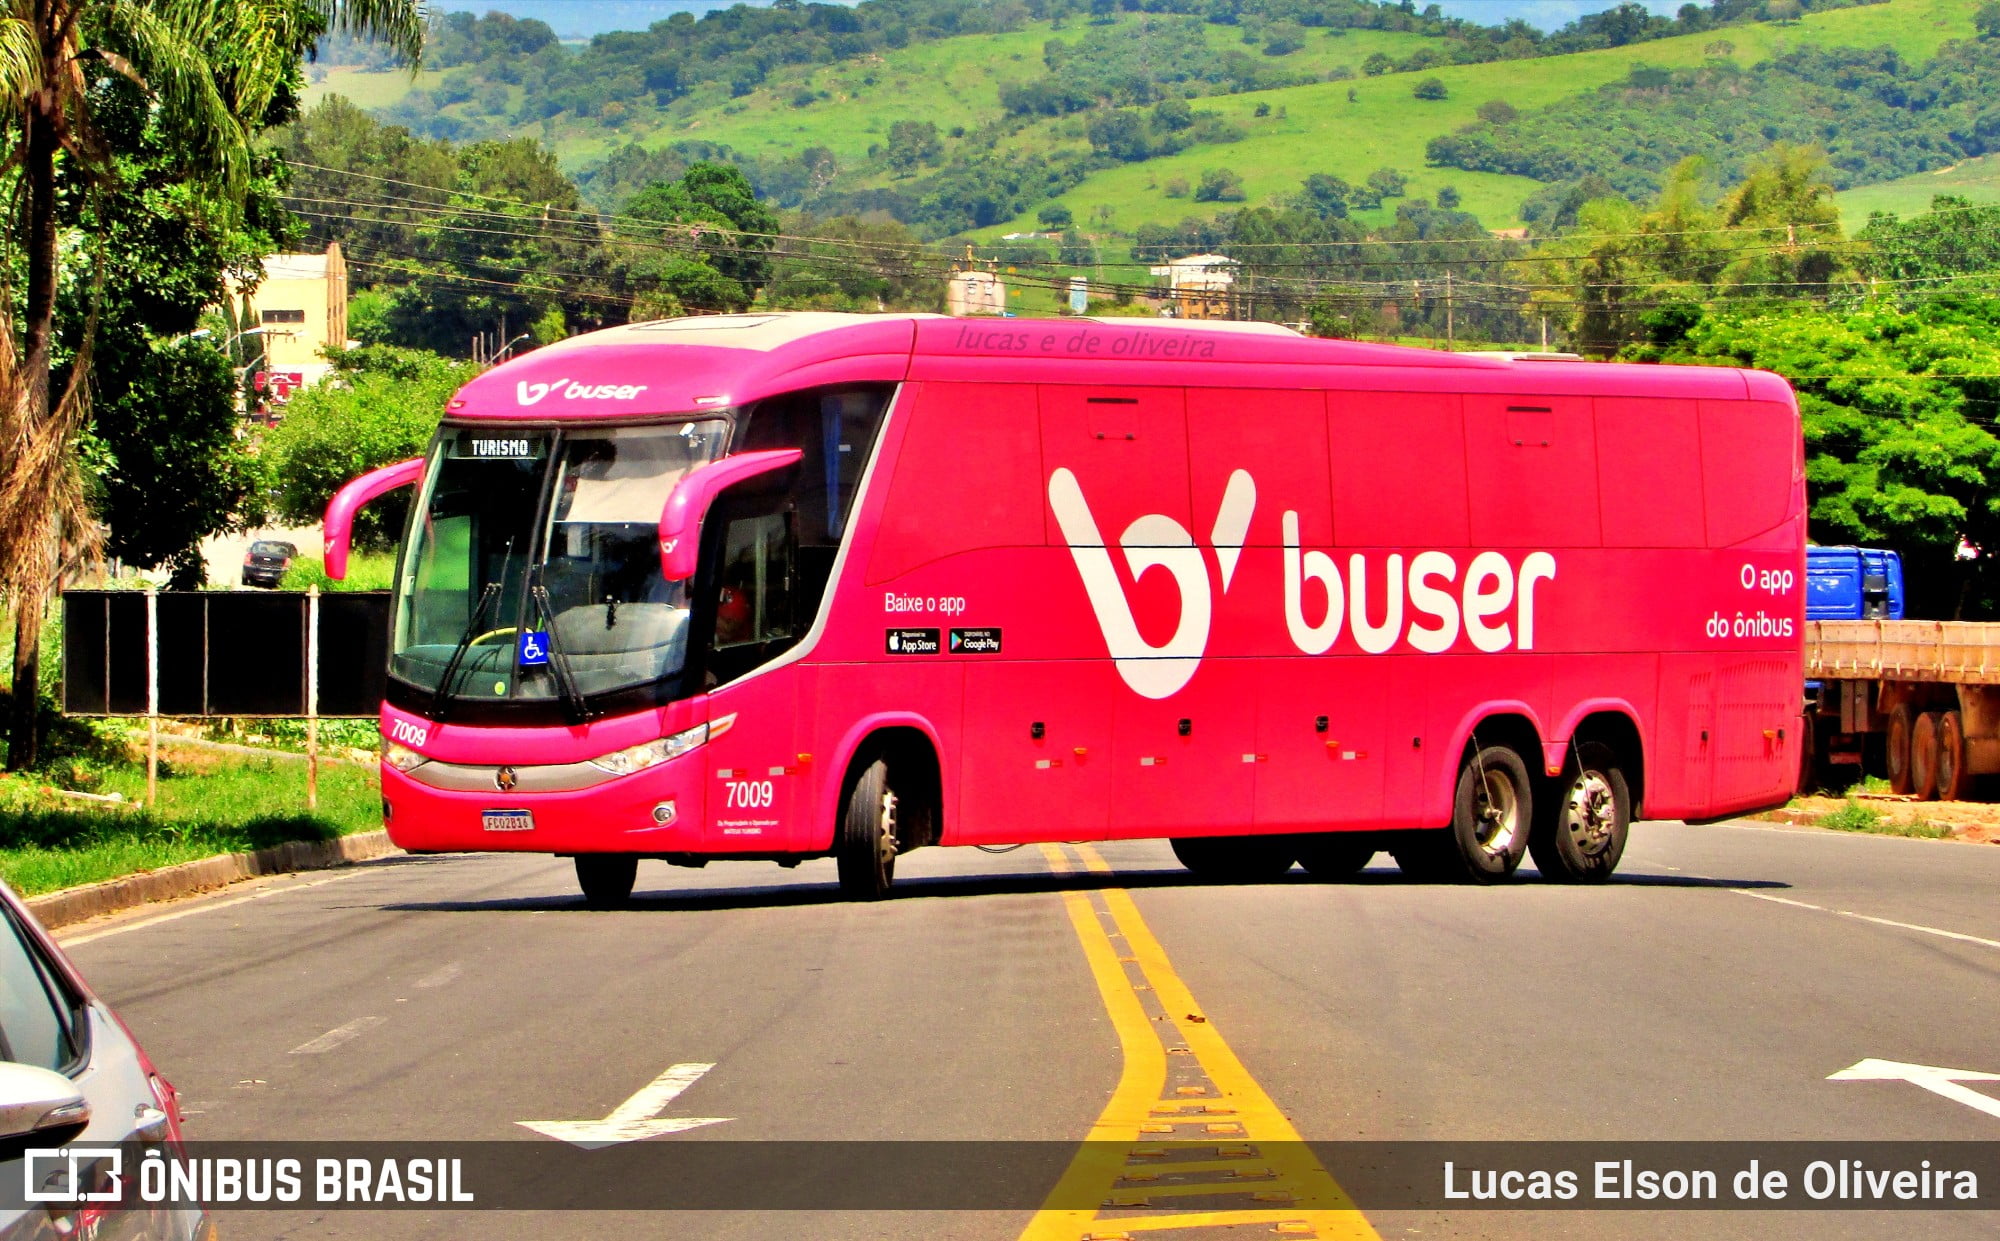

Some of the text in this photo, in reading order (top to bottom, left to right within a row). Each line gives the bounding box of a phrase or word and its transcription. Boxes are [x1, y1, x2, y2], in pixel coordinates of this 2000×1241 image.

[564, 381, 648, 400] buser
[472, 439, 529, 456] TURISMO
[1281, 509, 1556, 654] buser
[1740, 563, 1793, 595] O app
[885, 592, 966, 616] Baixe o app
[1706, 611, 1793, 638] do ônibus
[902, 639, 937, 653] App Store
[963, 638, 999, 651] Google Play
[392, 718, 427, 747] 7009
[725, 780, 773, 808] 7009
